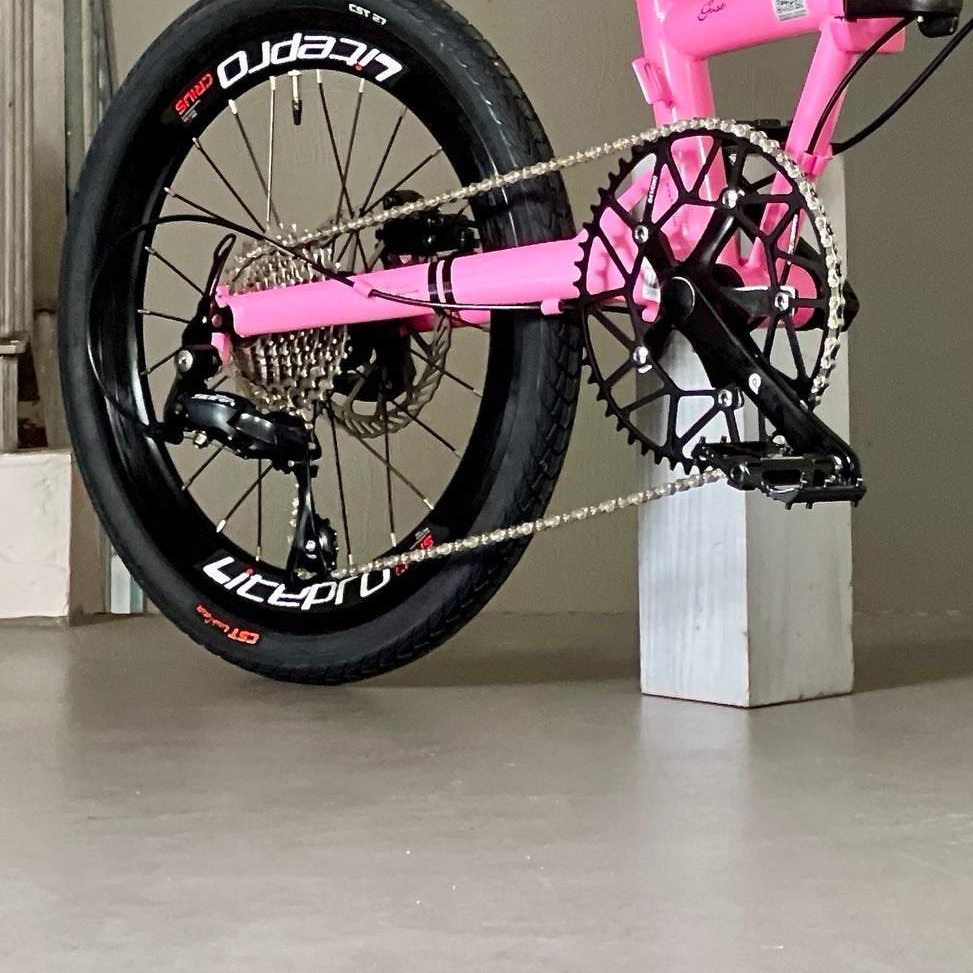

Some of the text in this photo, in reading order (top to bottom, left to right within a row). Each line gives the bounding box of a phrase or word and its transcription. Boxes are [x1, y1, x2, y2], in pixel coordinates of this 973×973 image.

[348, 3, 388, 26] CST 27
[175, 72, 214, 114] CRIUS
[227, 627, 261, 645] CST
